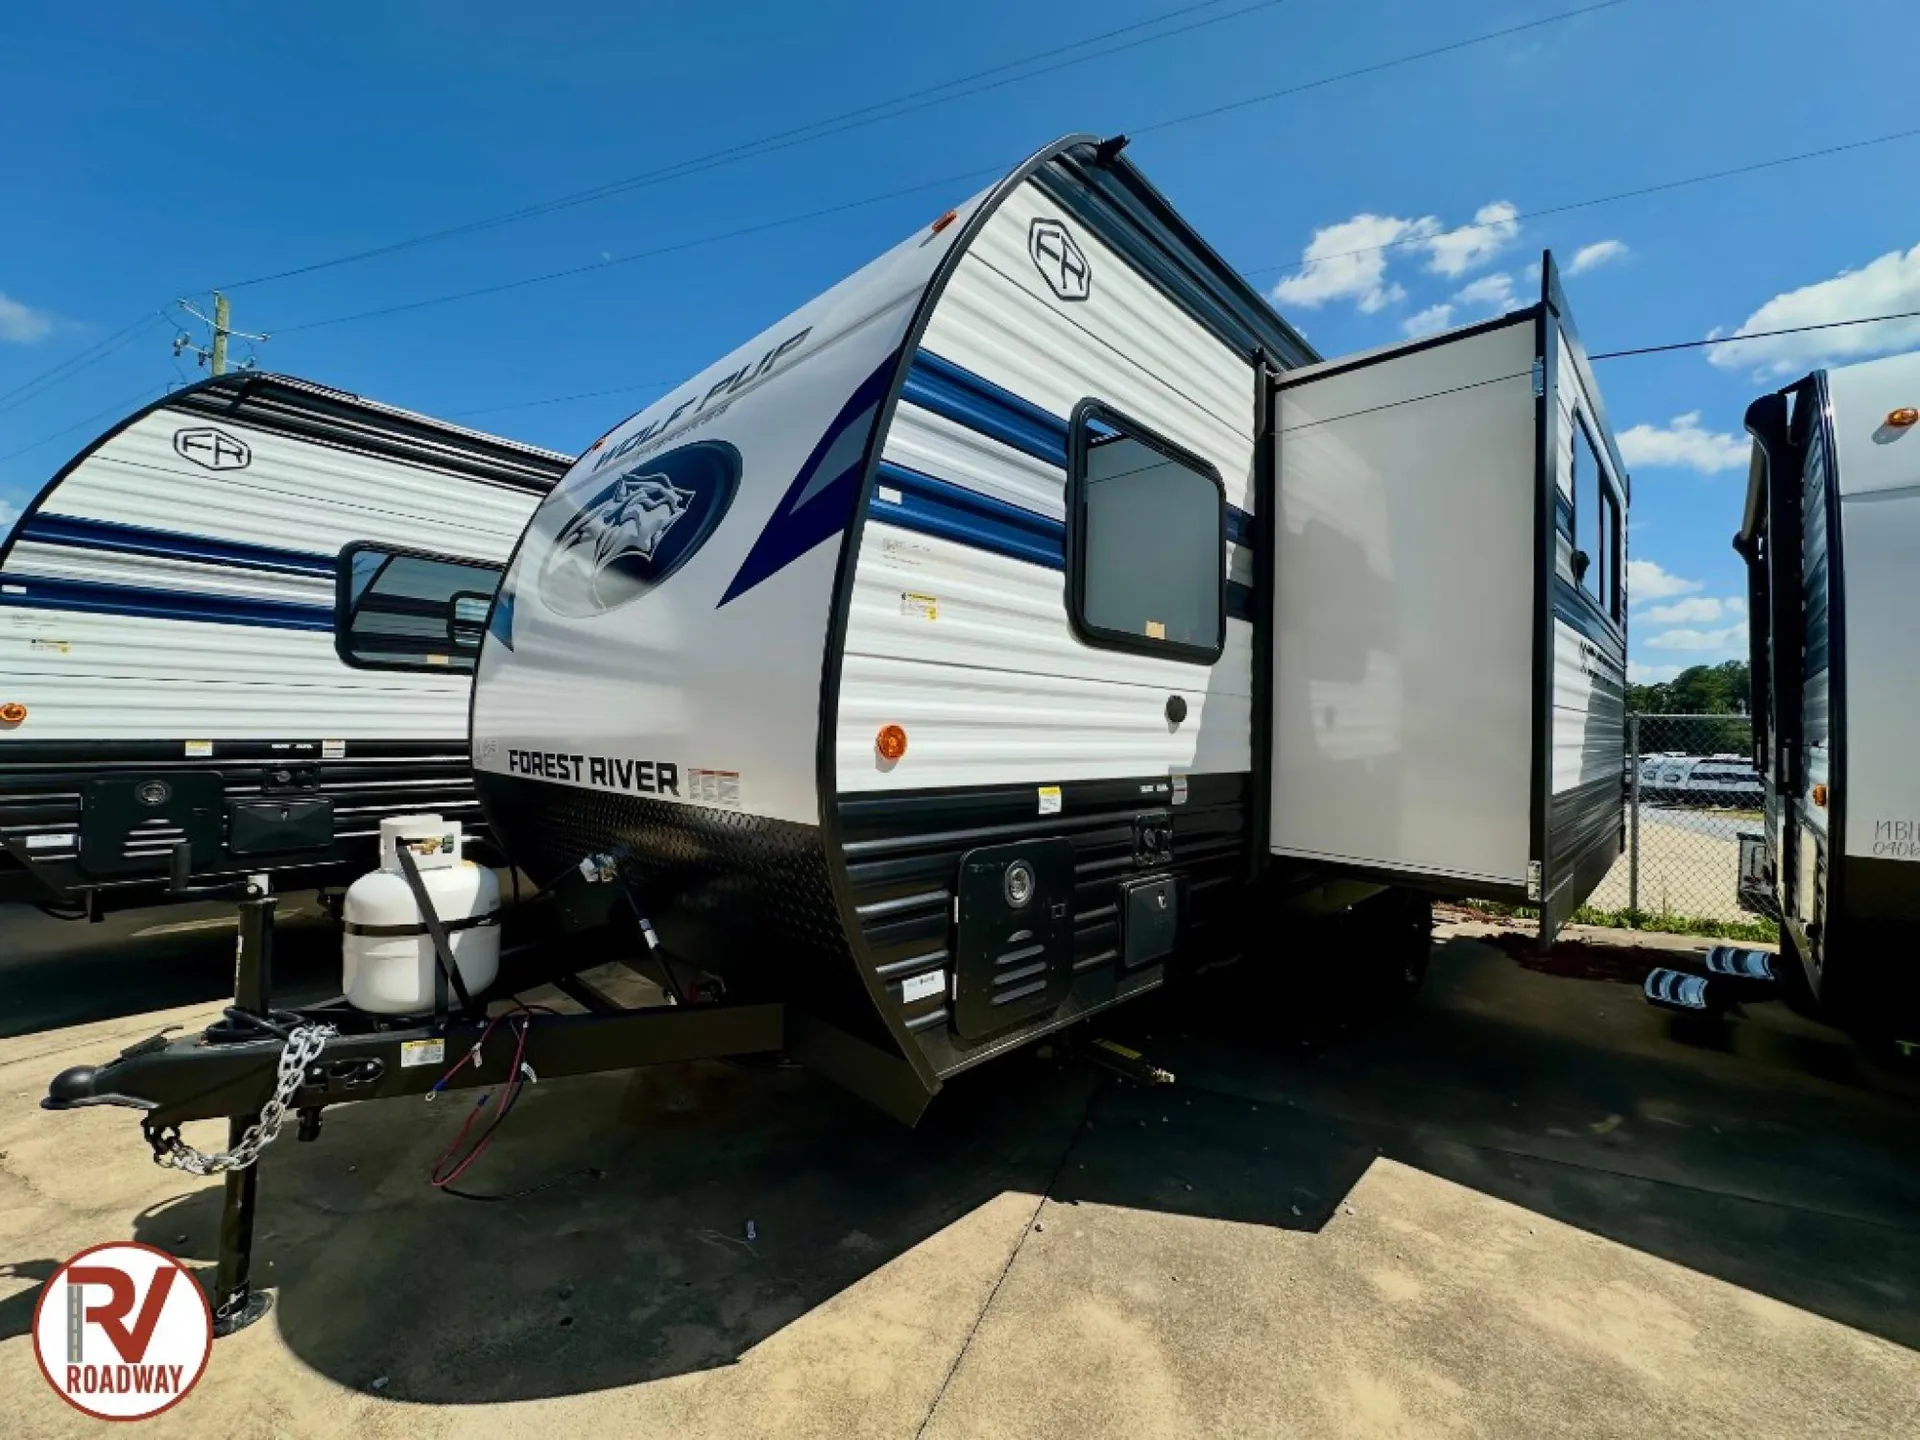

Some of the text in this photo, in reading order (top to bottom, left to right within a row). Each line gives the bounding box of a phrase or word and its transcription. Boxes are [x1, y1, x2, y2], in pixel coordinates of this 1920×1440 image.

[694, 325, 814, 414] PUP
[508, 749, 584, 783] FOREST
[588, 757, 681, 798] RIVER
